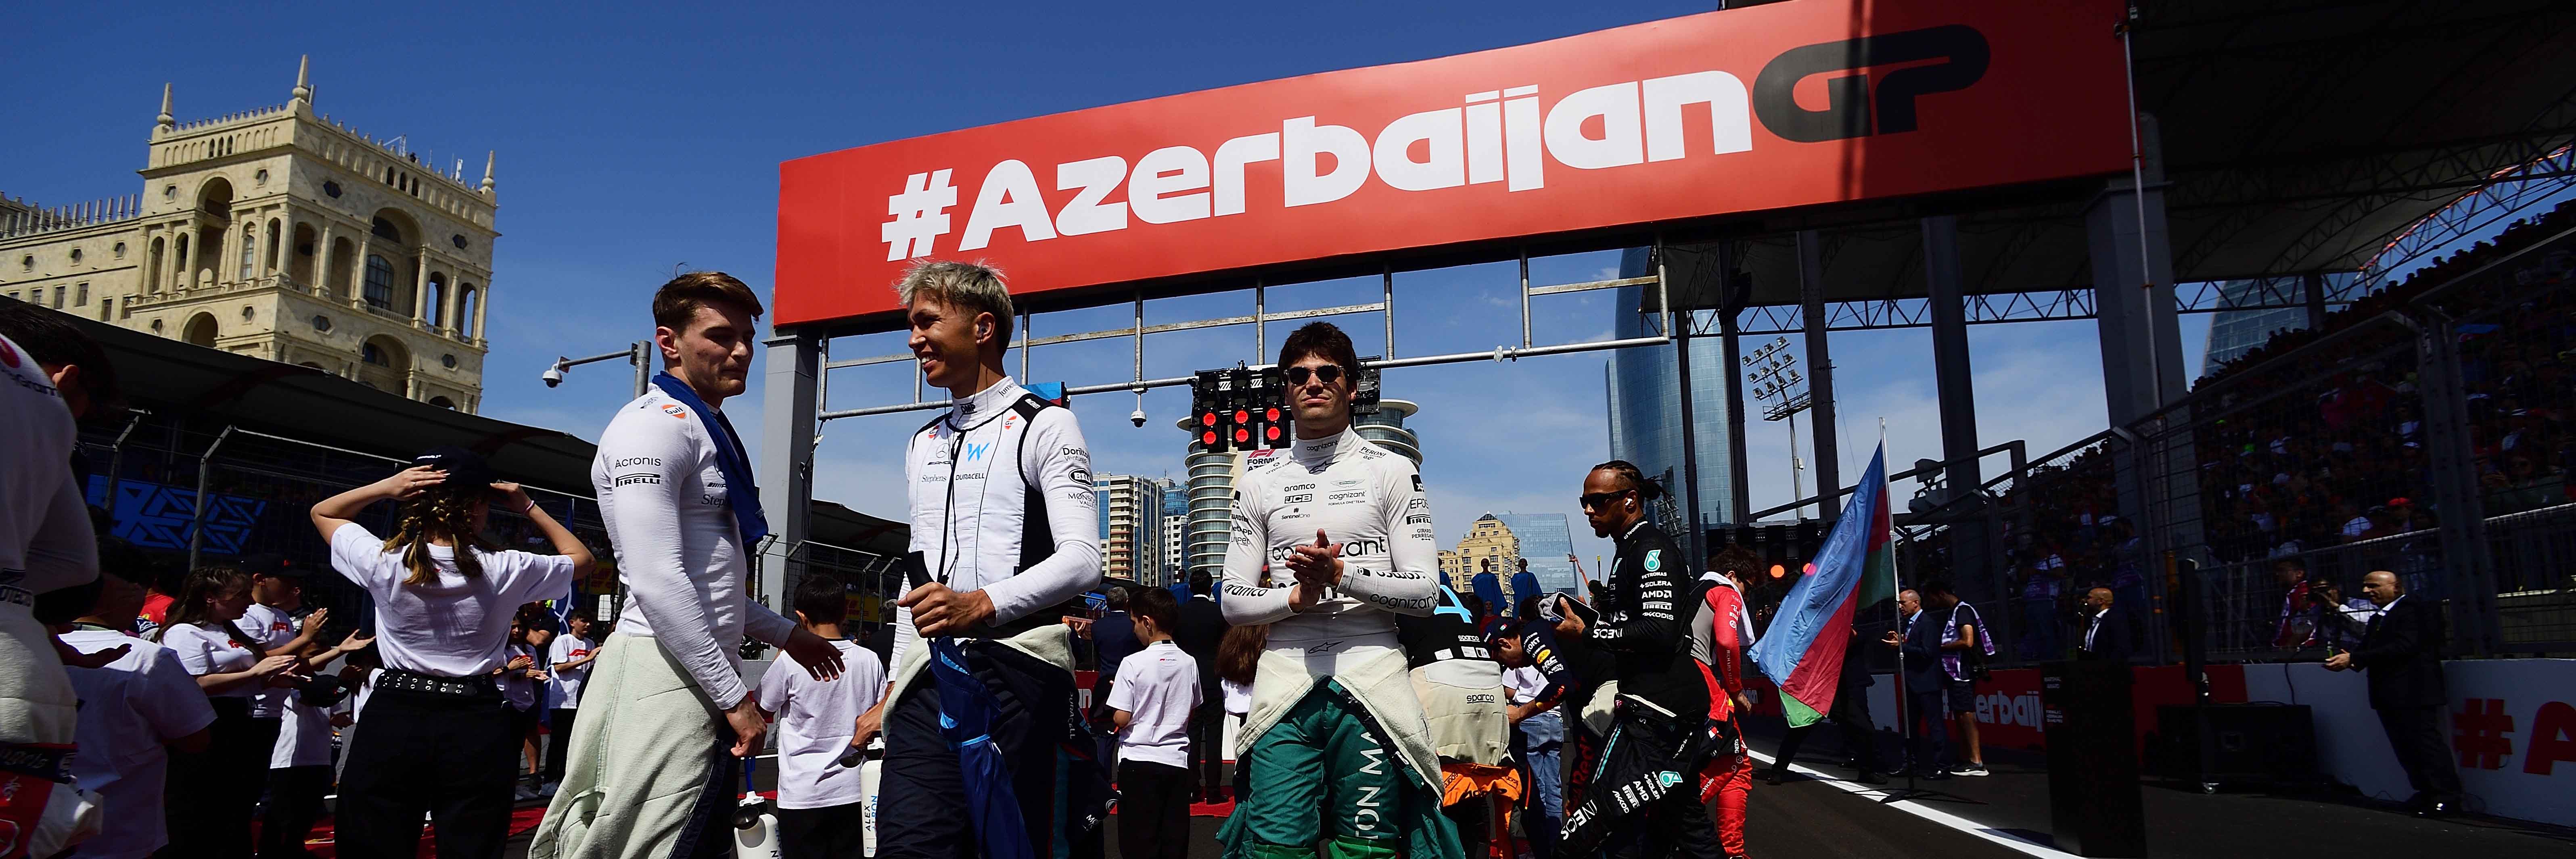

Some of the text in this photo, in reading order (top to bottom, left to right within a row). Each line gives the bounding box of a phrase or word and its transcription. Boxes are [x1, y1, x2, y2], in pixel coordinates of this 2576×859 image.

[665, 406, 684, 414] Gulf
[960, 403, 977, 414] OMP
[1307, 440, 1338, 452] cognizant
[1361, 447, 1386, 457] PERONI
[1062, 447, 1090, 459] Dorilto
[615, 457, 661, 470] Acronis
[1266, 461, 1292, 474] crypto.com
[615, 473, 661, 488] PIRELLI
[922, 474, 947, 483] Stephens
[1284, 483, 1315, 492] aramco
[701, 494, 726, 508] Step
[1284, 494, 1312, 504] JCB
[1329, 491, 1366, 500] cognizant
[1406, 514, 1432, 525] PIREL
[1272, 536, 1386, 561] cozant
[1224, 585, 1268, 597] aramco
[1641, 590, 1663, 599] AMD
[1370, 592, 1438, 609] cognizant
[1434, 585, 1472, 623] 4
[1643, 601, 1672, 610] PIRELLI
[1526, 637, 1540, 654] ROKT
[1466, 693, 1495, 704] sparco
[1622, 784, 1640, 809] PIREL
[1633, 781, 1650, 801] AMD
[1612, 790, 1630, 814] AKKOD
